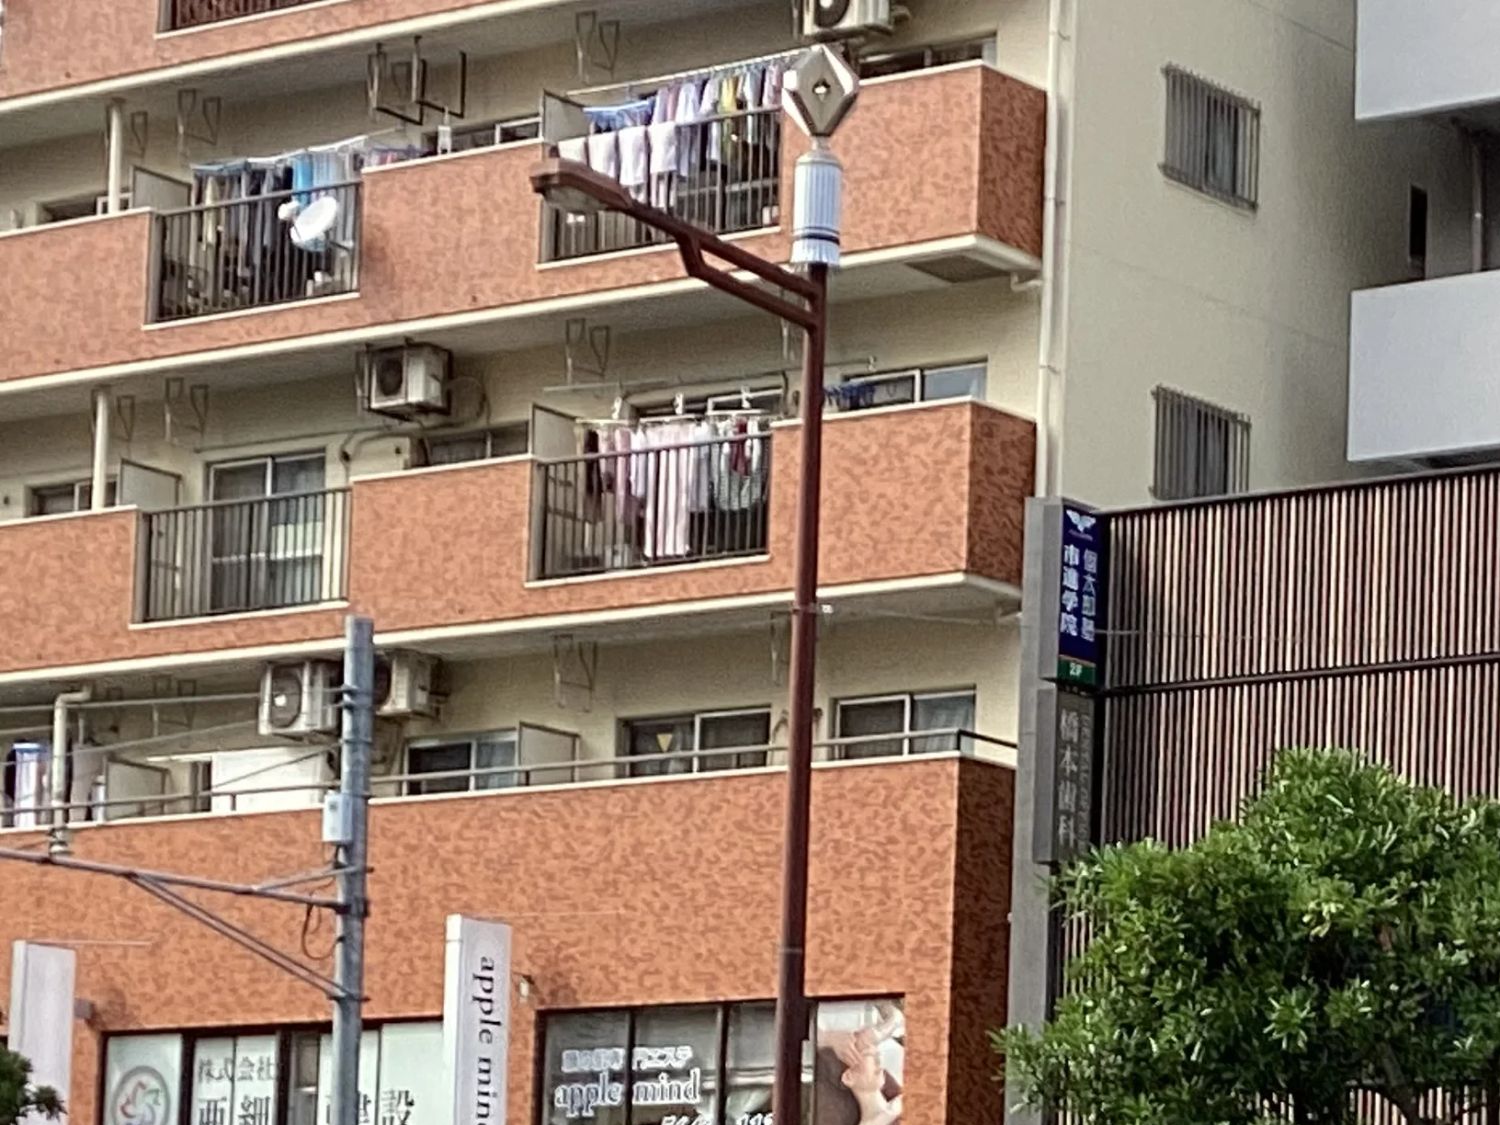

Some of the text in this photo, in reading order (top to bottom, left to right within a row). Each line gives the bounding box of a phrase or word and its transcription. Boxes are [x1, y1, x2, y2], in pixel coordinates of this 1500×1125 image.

[472, 956, 502, 1045] apple
[198, 1055, 277, 1083] 株式会社
[555, 1069, 701, 1118] apple mind
